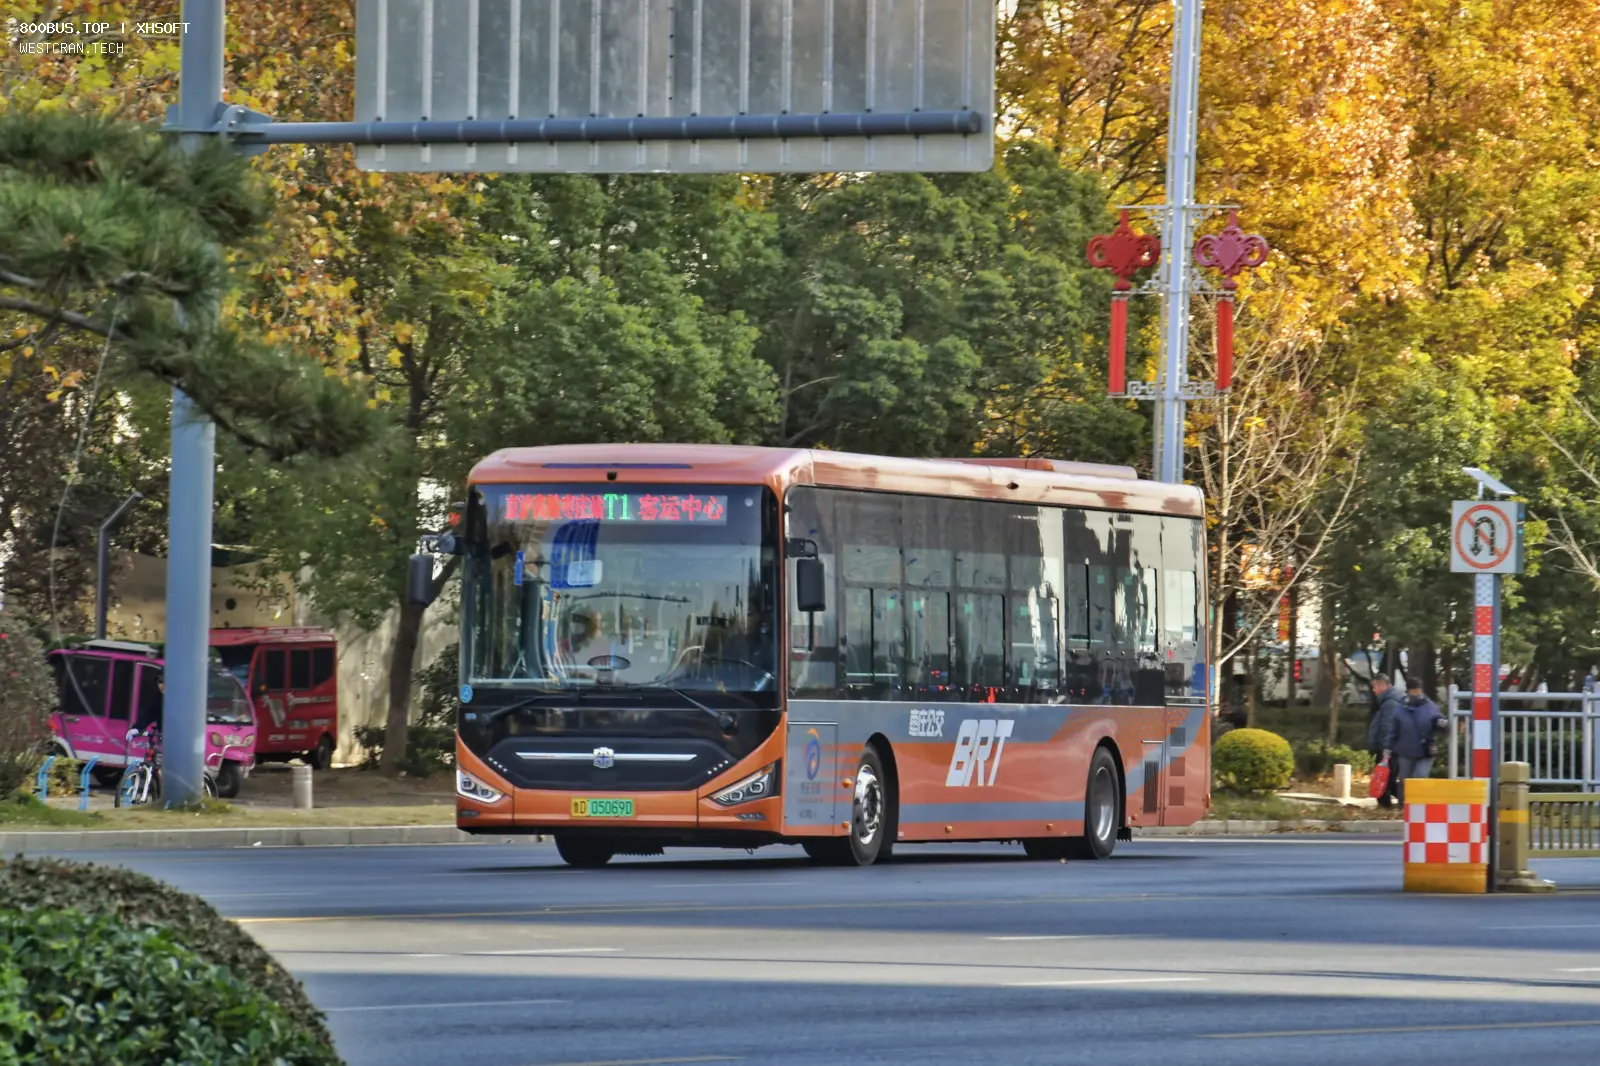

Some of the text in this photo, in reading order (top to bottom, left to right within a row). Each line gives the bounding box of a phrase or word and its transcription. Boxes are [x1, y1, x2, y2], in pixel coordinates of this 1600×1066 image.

[603, 493, 631, 520] T1
[638, 493, 724, 521] 客运中心
[945, 719, 1015, 787] BRT
[591, 800, 633, 815] 05069D
